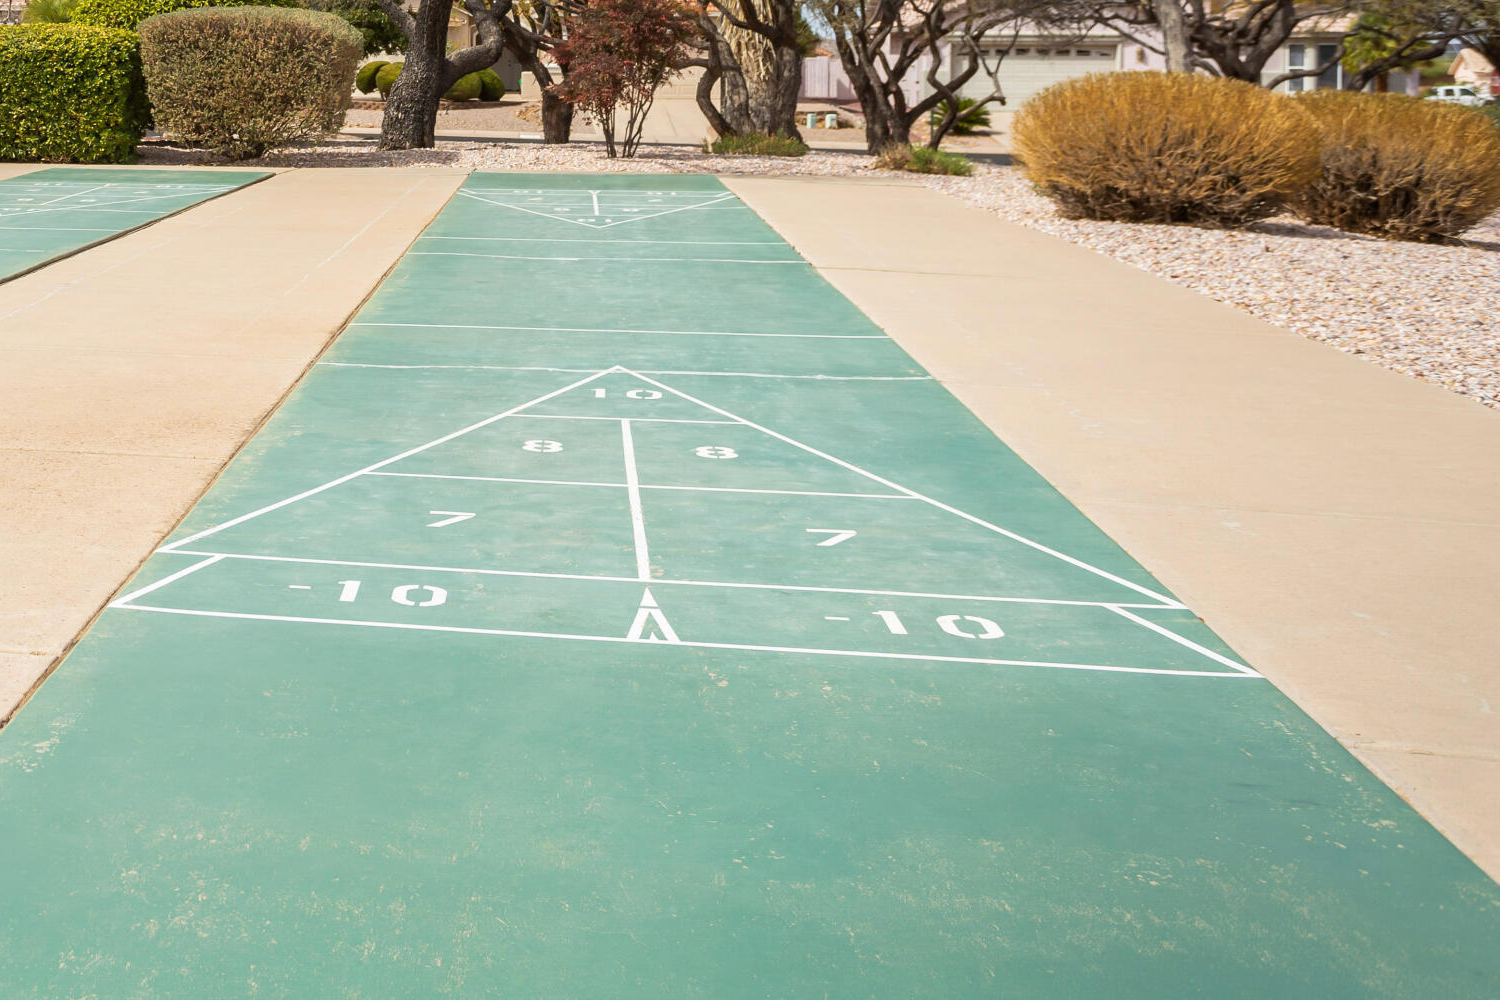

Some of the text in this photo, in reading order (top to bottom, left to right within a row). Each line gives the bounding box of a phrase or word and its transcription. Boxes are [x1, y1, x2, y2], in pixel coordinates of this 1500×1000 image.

[590, 387, 664, 400] 10
[521, 439, 564, 453] 8
[694, 445, 740, 460] 8
[425, 509, 477, 528] 7
[805, 527, 858, 547] 7
